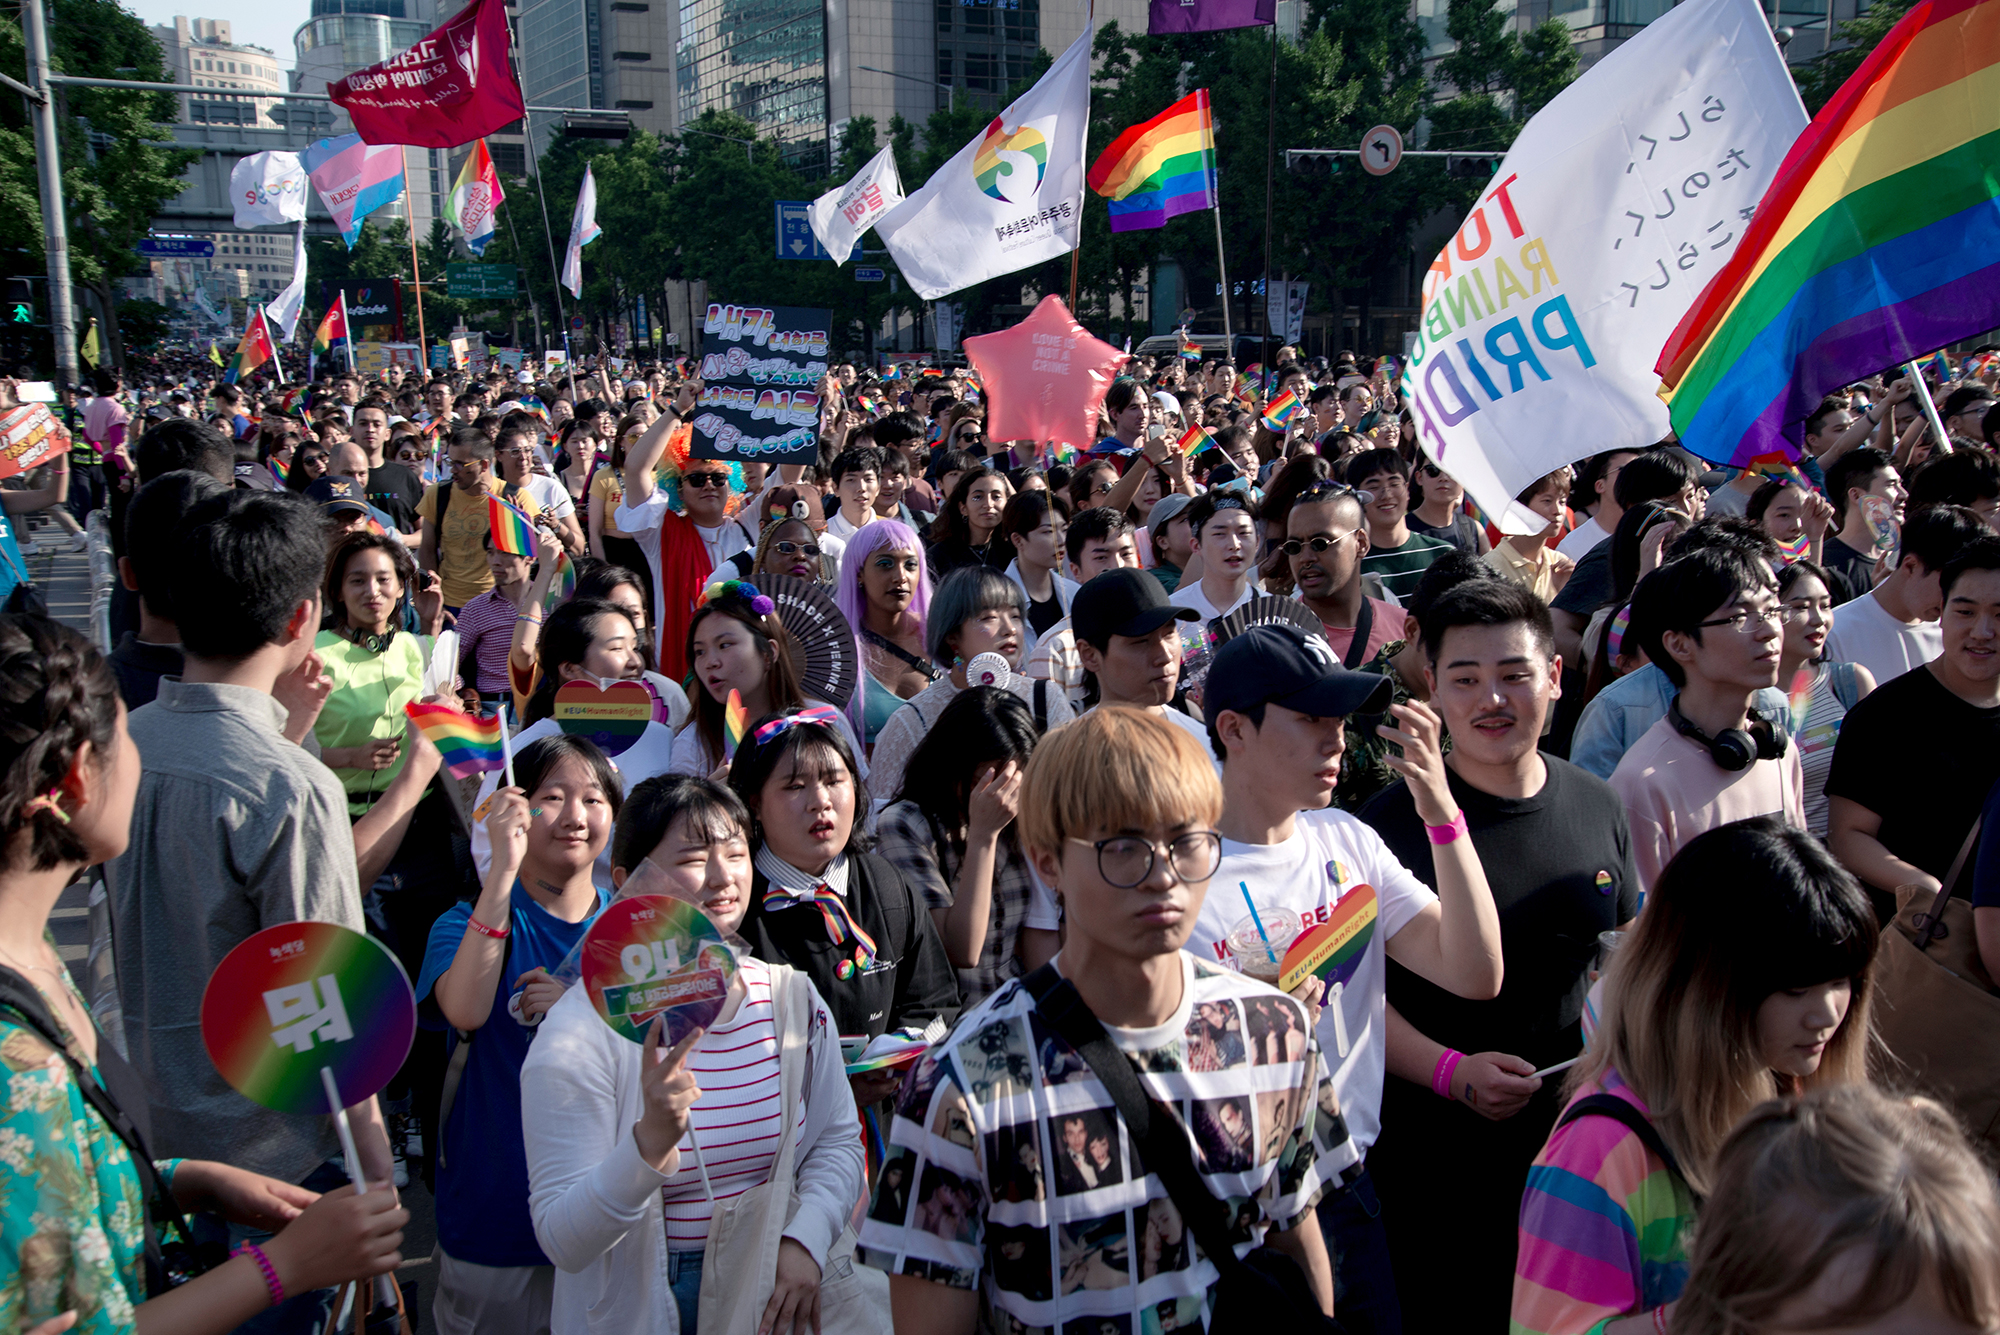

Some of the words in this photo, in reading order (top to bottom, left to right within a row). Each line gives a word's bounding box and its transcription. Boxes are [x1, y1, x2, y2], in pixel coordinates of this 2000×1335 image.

[704, 303, 776, 346] 내가
[768, 330, 829, 356] 너희를
[1032, 332, 1063, 347] LOVE
[1064, 337, 1077, 350] IS
[701, 346, 828, 386] 사랑한것처럼
[1032, 359, 1071, 375] CRIME
[1035, 347, 1059, 360] NOT
[1060, 350, 1071, 361] A
[697, 385, 757, 412] 너희도
[750, 389, 821, 427] 서로
[693, 412, 816, 458] 사랑하여라
[777, 593, 825, 624] SHADE
[822, 625, 835, 637] X
[824, 641, 842, 694] FEMME
[564, 707, 644, 717] #EU4HumanRight
[630, 909, 656, 921] 녹색당
[269, 939, 305, 958] 녹색당
[1289, 910, 1370, 985] #EU4HumanRight
[261, 973, 354, 1054] 뭐
